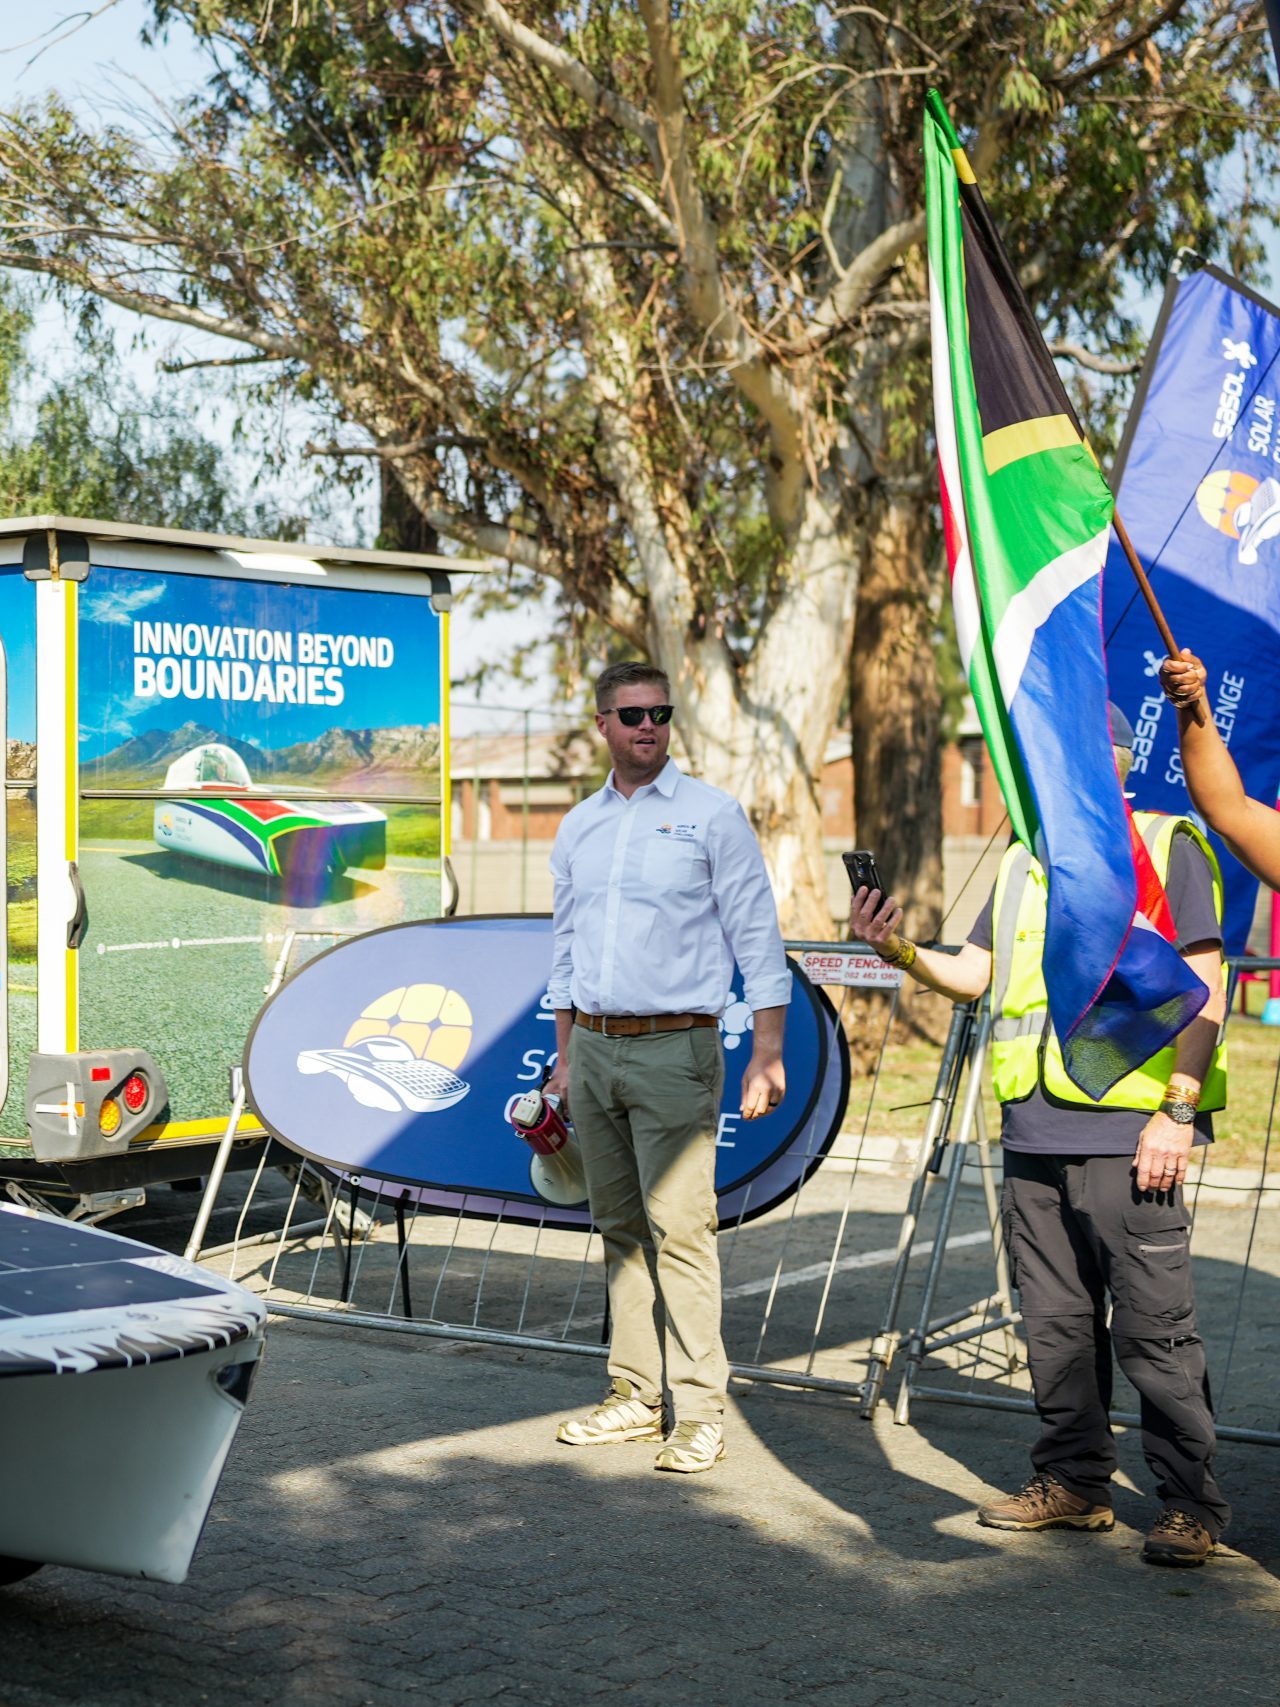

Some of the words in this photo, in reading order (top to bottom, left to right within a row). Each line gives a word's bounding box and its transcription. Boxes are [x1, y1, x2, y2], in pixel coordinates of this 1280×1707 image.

[1247, 394, 1276, 457] SOLAR
[133, 620, 292, 662] INNOVATION
[298, 633, 394, 668] BEYOND
[133, 656, 345, 707] BOUNDARIES
[805, 957, 843, 968] SPEED
